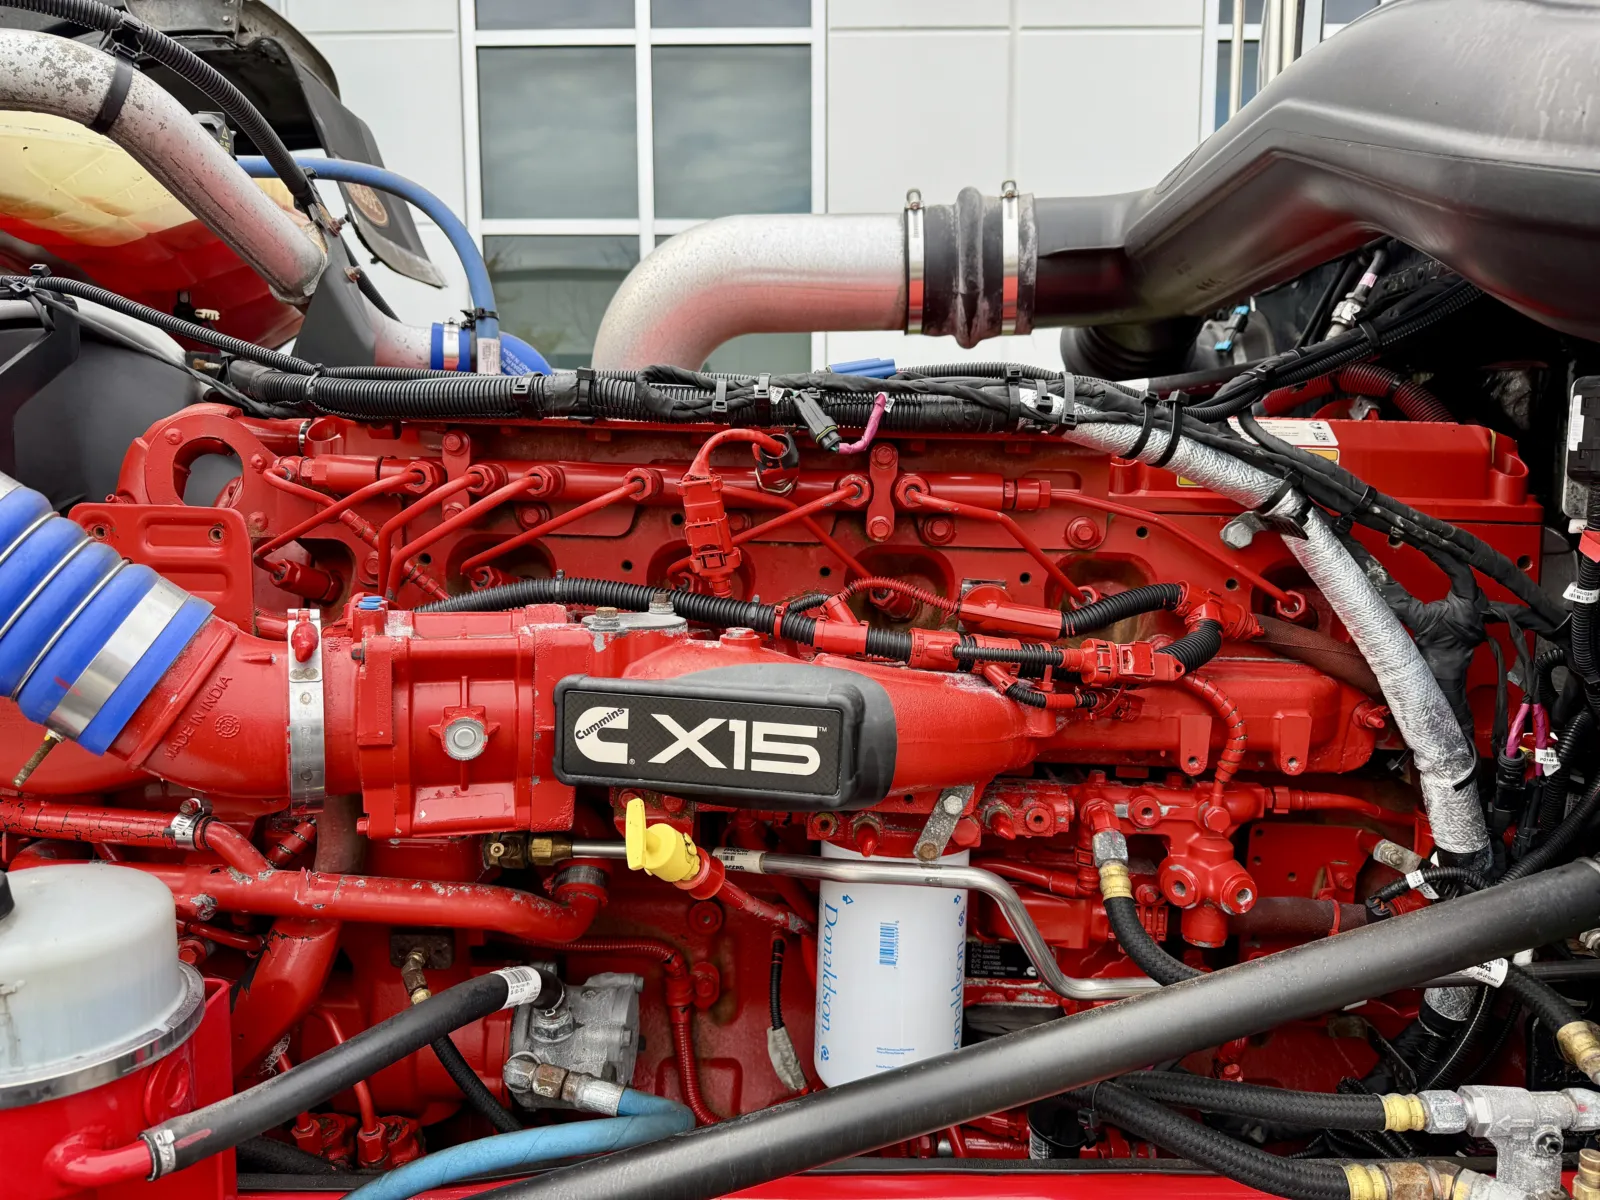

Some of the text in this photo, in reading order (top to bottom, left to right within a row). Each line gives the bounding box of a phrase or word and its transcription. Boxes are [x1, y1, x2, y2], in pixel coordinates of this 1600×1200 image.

[164, 676, 233, 760] MADE IN INDIA
[575, 707, 626, 740] Cummins
